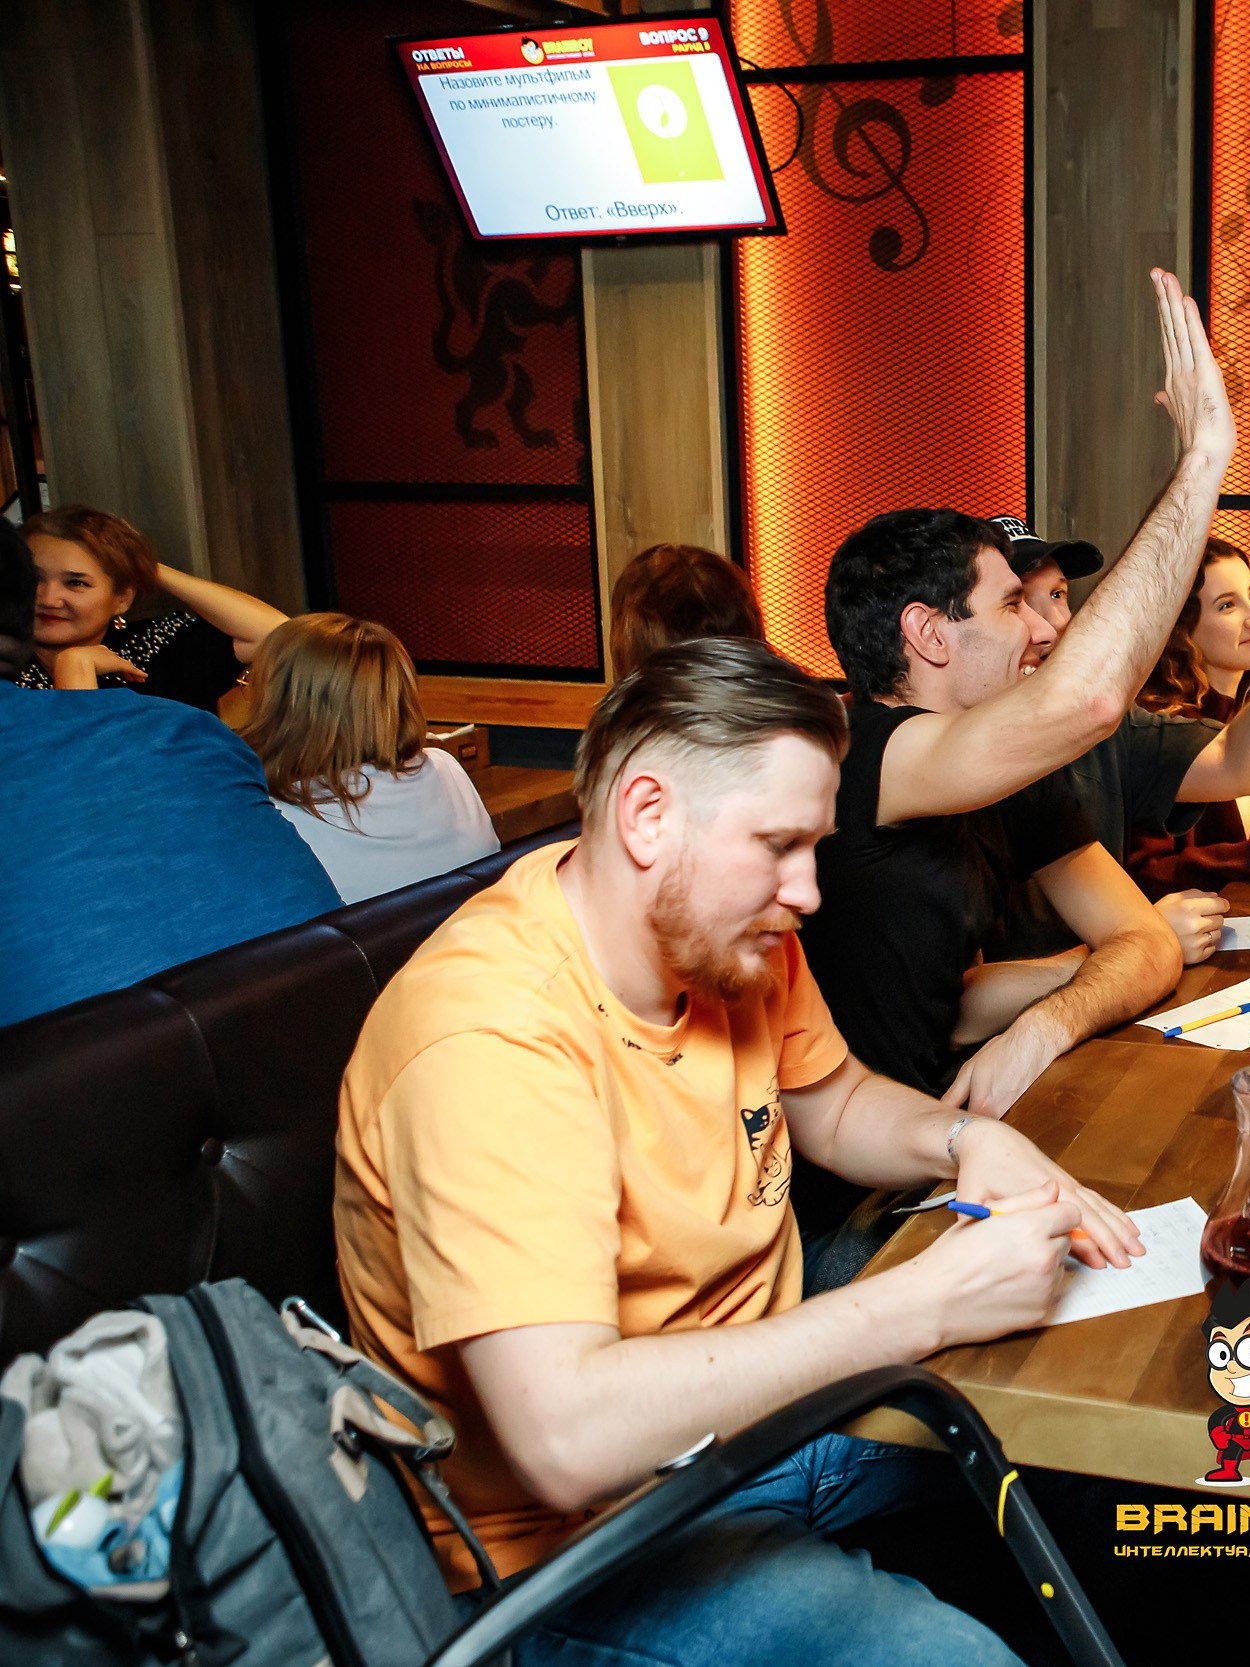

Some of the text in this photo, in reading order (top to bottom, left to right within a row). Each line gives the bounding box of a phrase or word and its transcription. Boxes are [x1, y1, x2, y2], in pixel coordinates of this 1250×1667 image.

[639, 27, 709, 46] ВОПРОС 9
[412, 46, 465, 63] ОТВЕТЫ
[416, 60, 472, 71] НА ВОПРОСЫ
[440, 68, 592, 90] Назовите мультфильм
[449, 91, 597, 112] по минималистичному
[545, 204, 602, 221] Ответ:
